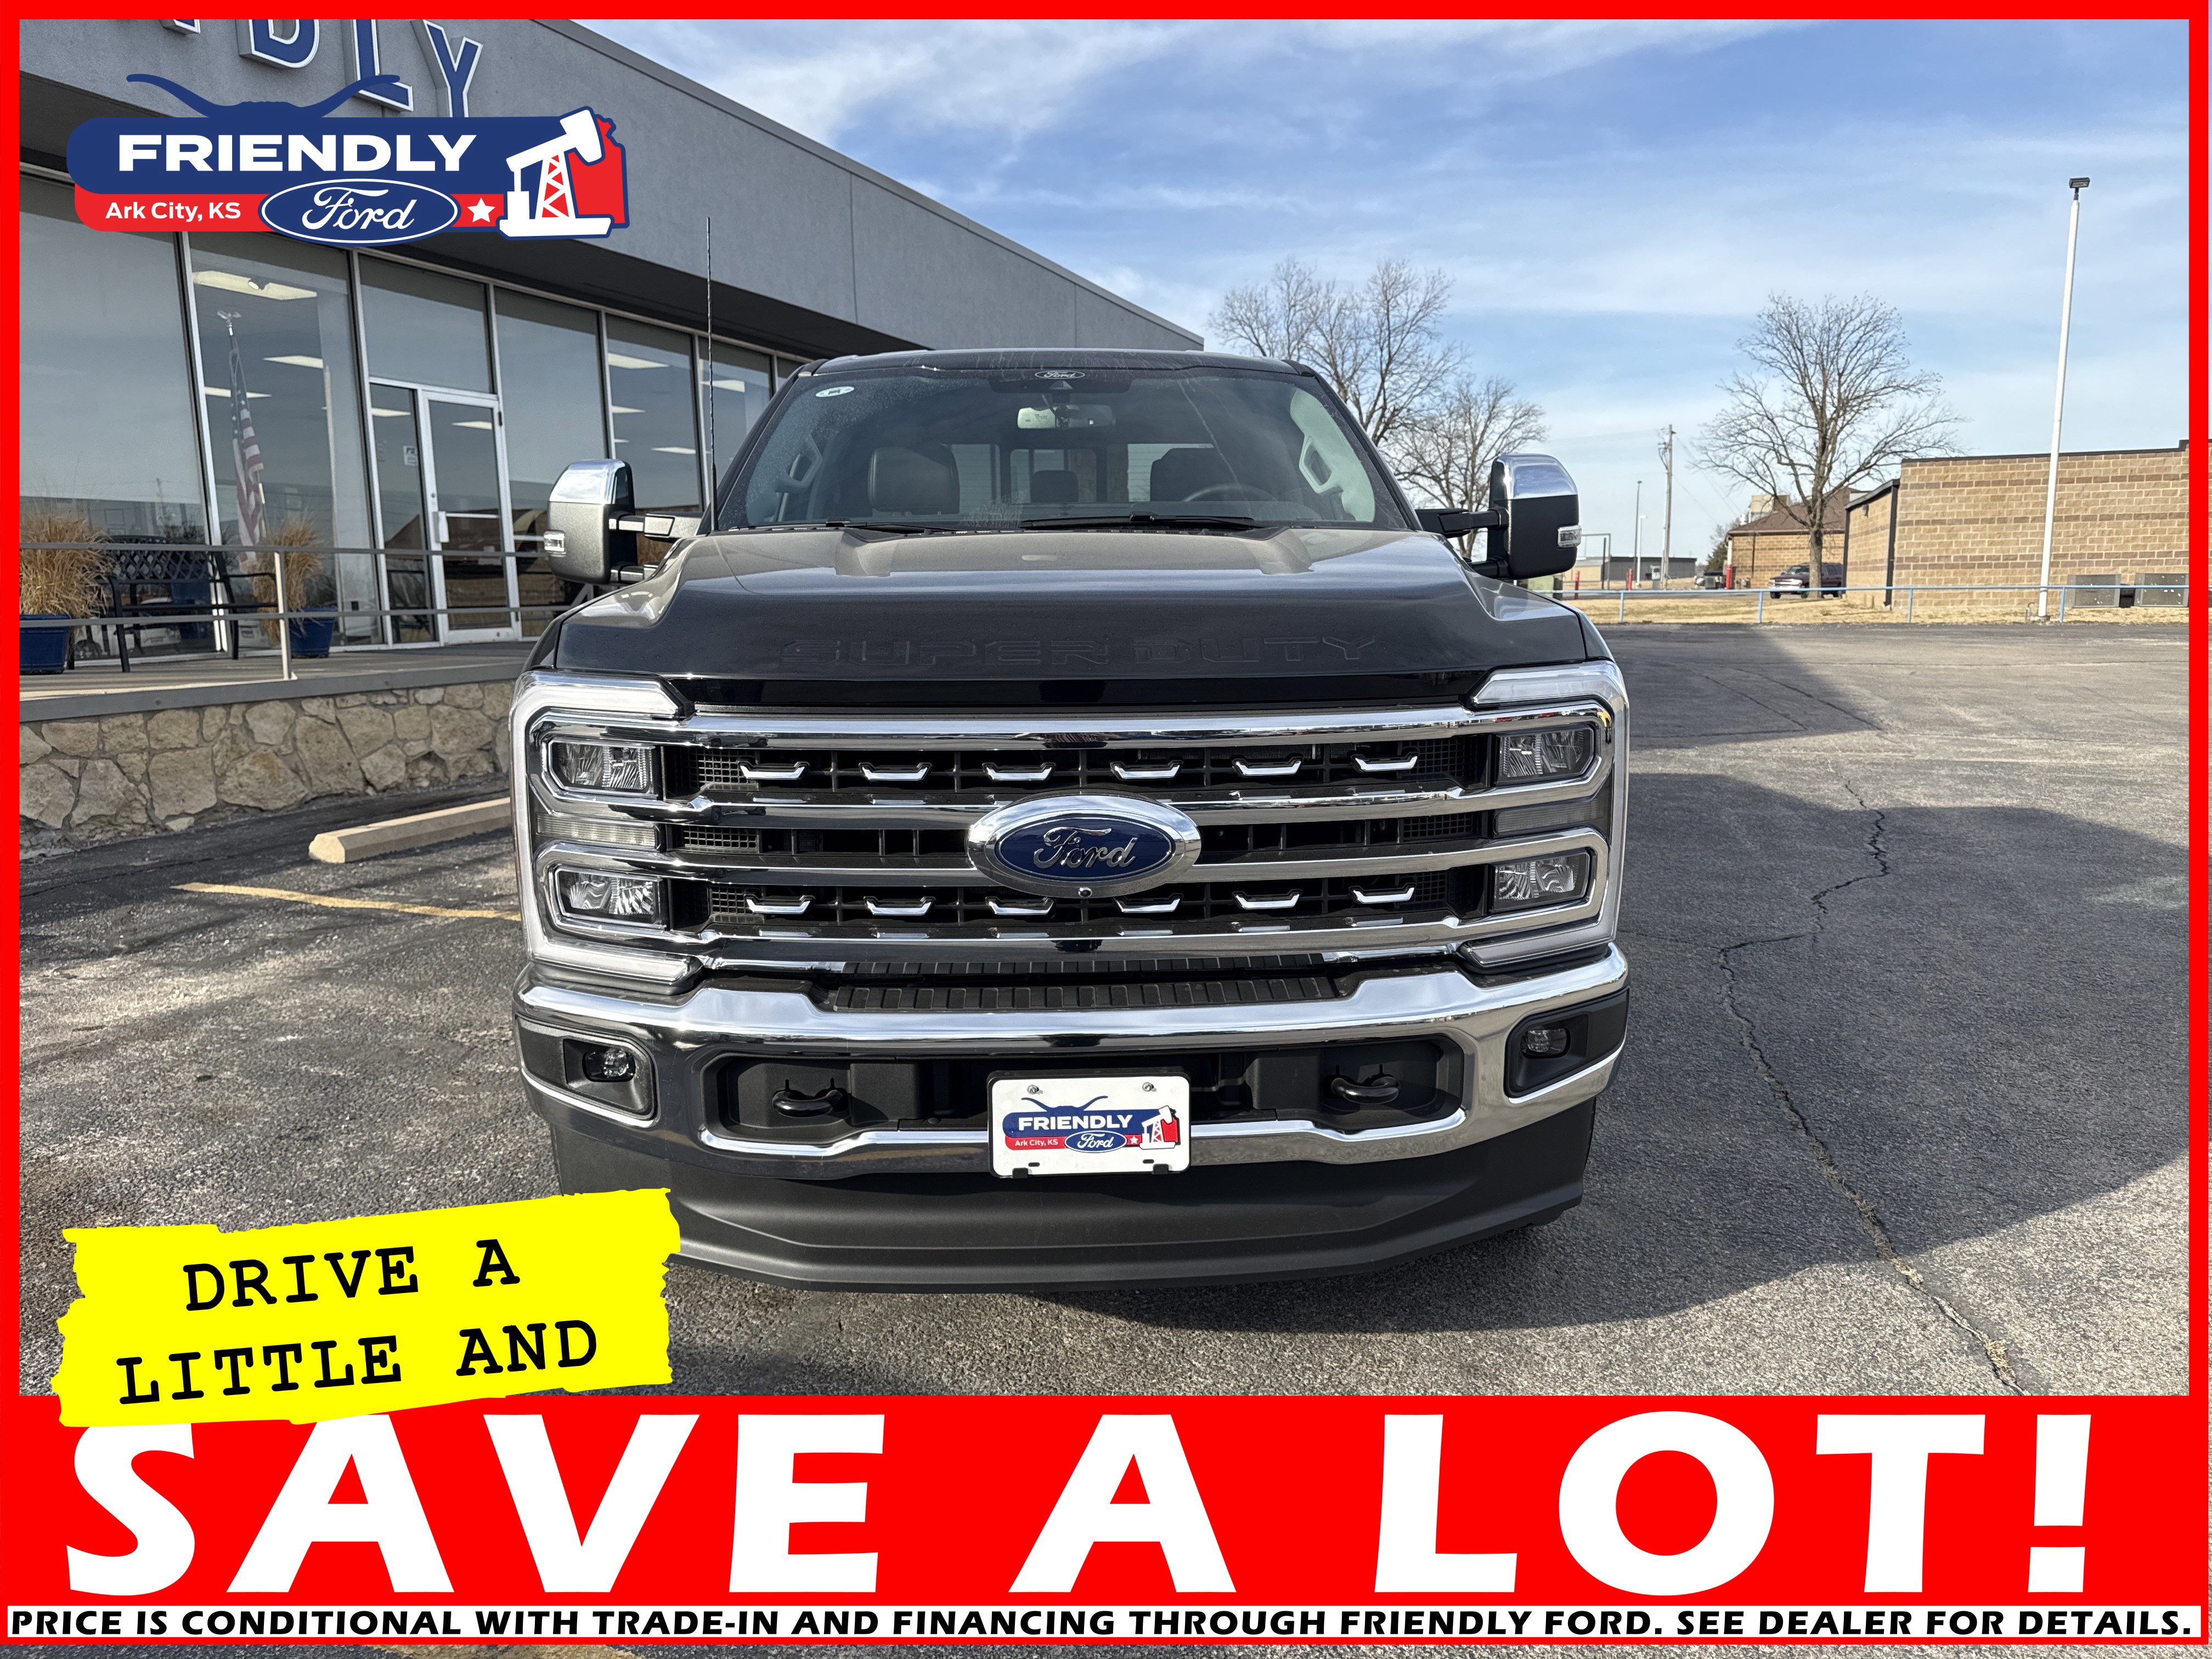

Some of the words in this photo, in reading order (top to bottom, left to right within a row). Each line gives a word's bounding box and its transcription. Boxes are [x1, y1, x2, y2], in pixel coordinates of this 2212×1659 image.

[172, 19, 483, 117] LY
[781, 640, 1109, 665] SUPER
[1133, 636, 1376, 664] DUTY
[1034, 827, 1138, 868] Ford
[1019, 1115, 1132, 1130] FRIENDLY
[1029, 1138, 1046, 1147] City,
[1077, 1133, 1114, 1148] Ford
